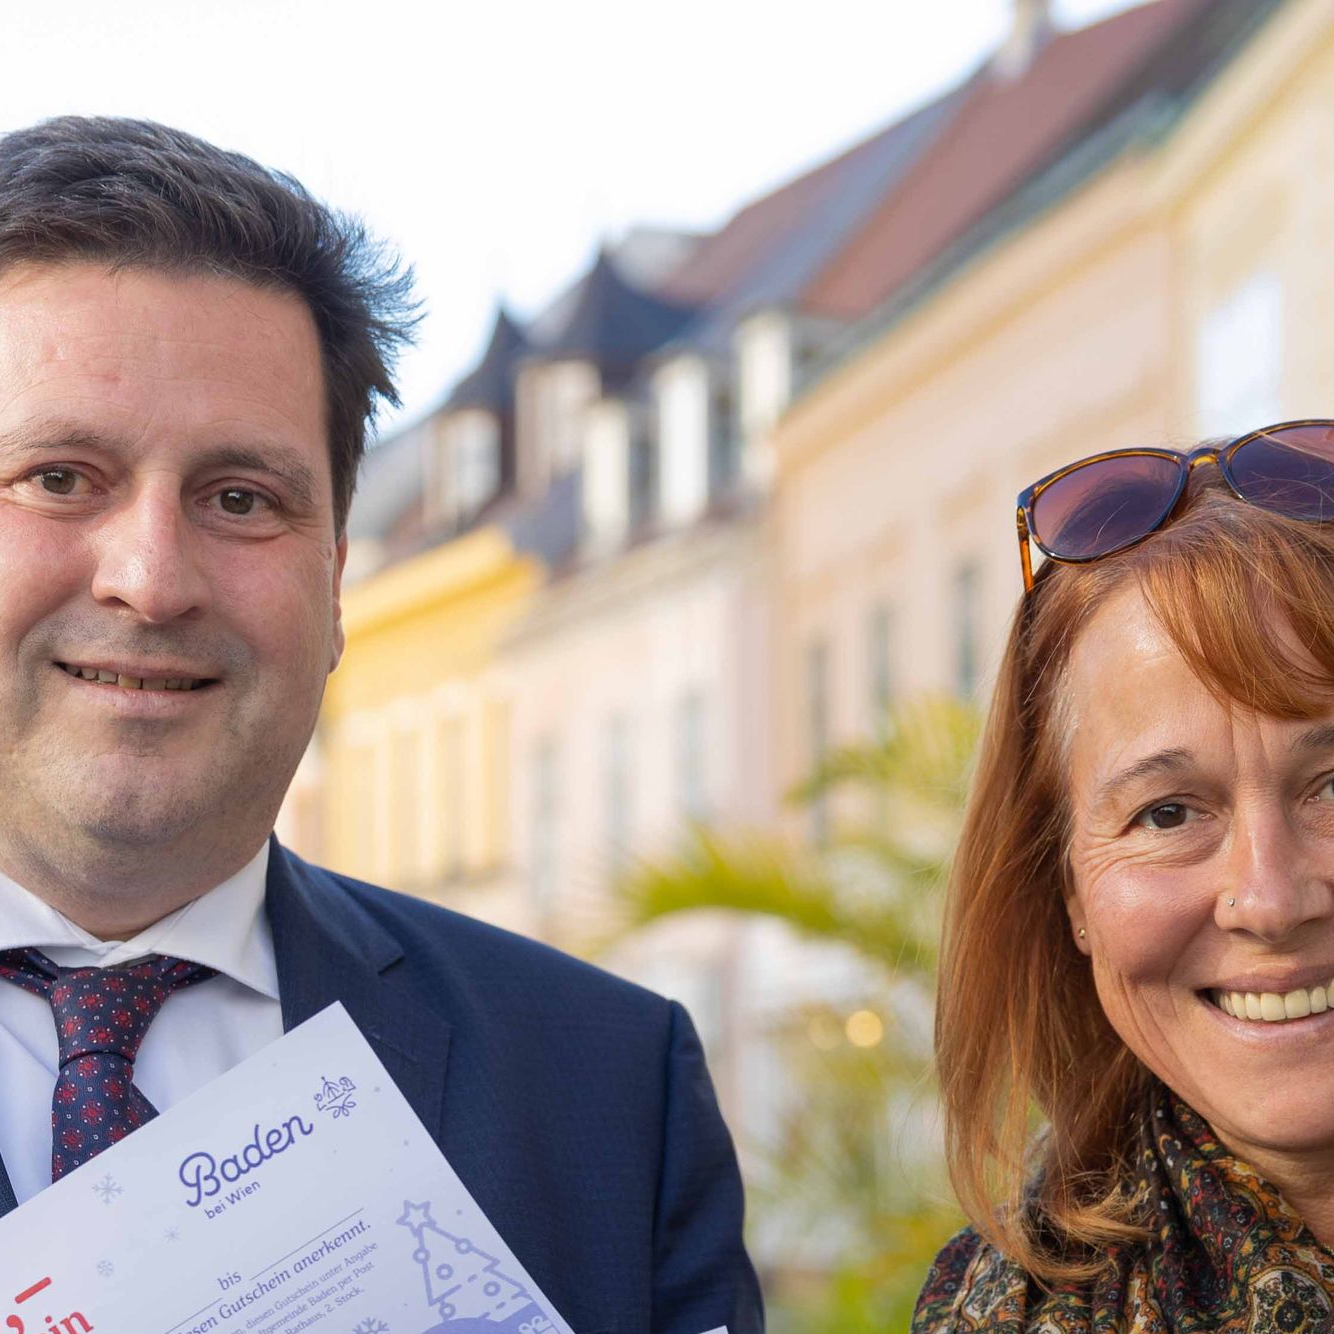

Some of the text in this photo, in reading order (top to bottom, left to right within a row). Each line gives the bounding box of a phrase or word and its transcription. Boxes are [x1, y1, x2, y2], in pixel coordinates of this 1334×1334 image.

[178, 1115, 314, 1208] Baden
[203, 1181, 261, 1220] bei Wien
[216, 1271, 242, 1291] bis
[218, 1270, 292, 1320] Gutschein
[293, 1219, 371, 1274] anerkennt.
[274, 1280, 320, 1311] Gutschein
[318, 1263, 343, 1283] unter
[306, 1285, 338, 1307] Baden
